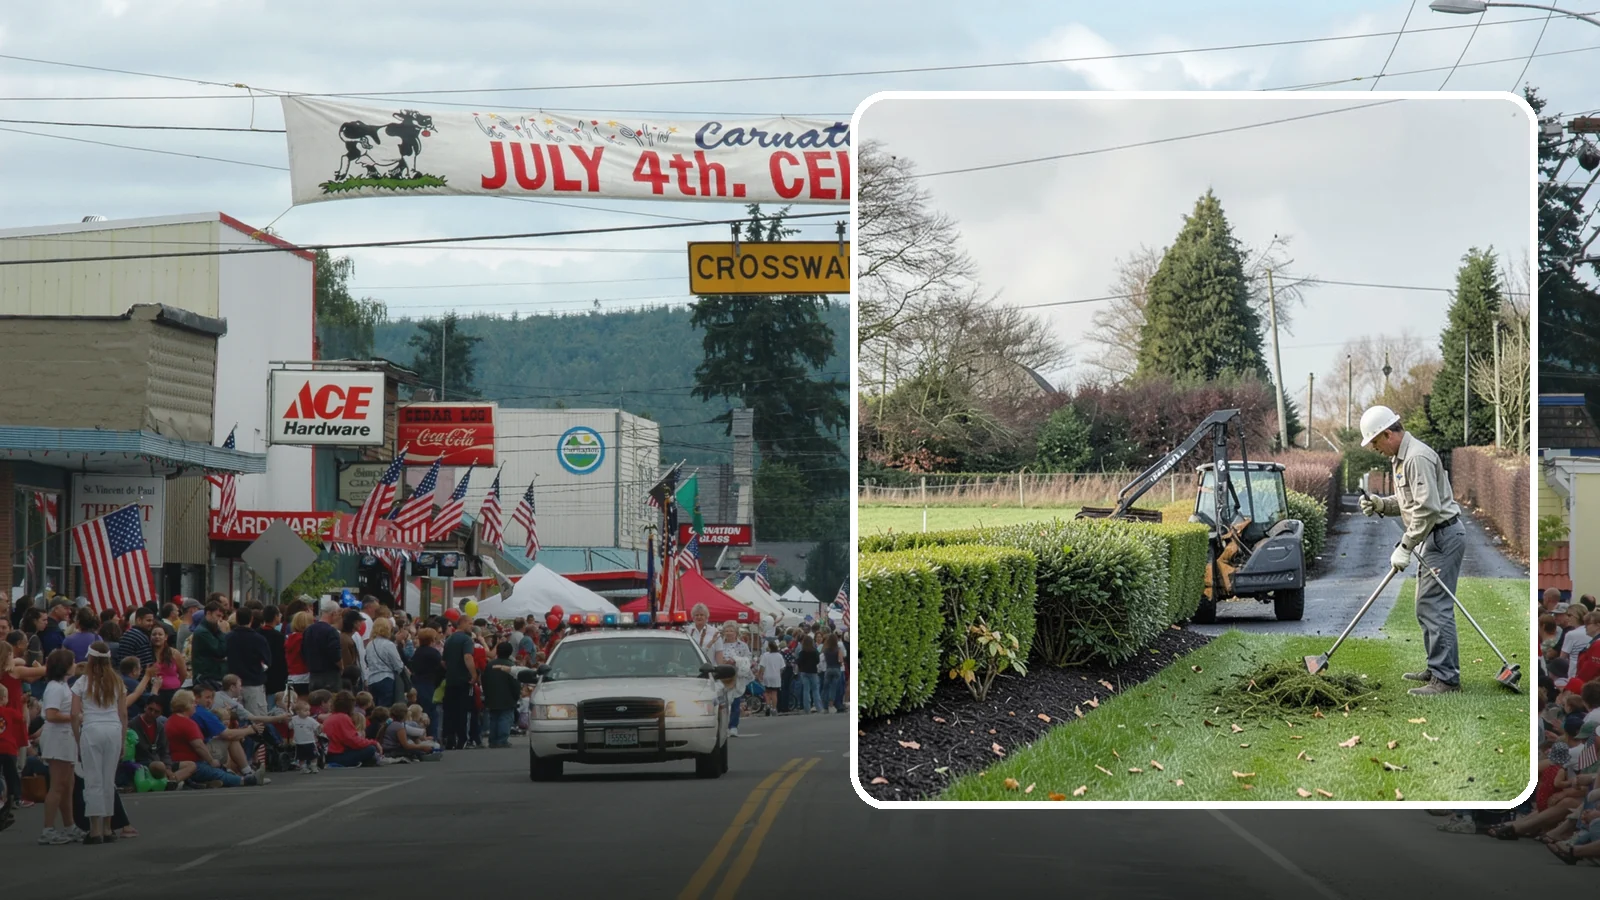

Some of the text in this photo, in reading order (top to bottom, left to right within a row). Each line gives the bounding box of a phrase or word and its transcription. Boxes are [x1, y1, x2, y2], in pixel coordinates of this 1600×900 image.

[481, 141, 604, 192] JULY
[632, 150, 746, 197] 4th.
[697, 254, 850, 280] CROSSWA
[283, 380, 373, 420] ACE
[406, 409, 485, 422] CEDAR LOG
[283, 421, 370, 436] Hardware
[416, 428, 476, 447] Coca-Cola
[83, 485, 155, 495] St. Vincent de Paul
[688, 526, 741, 535] CRNATION
[699, 535, 730, 543] GLASS
